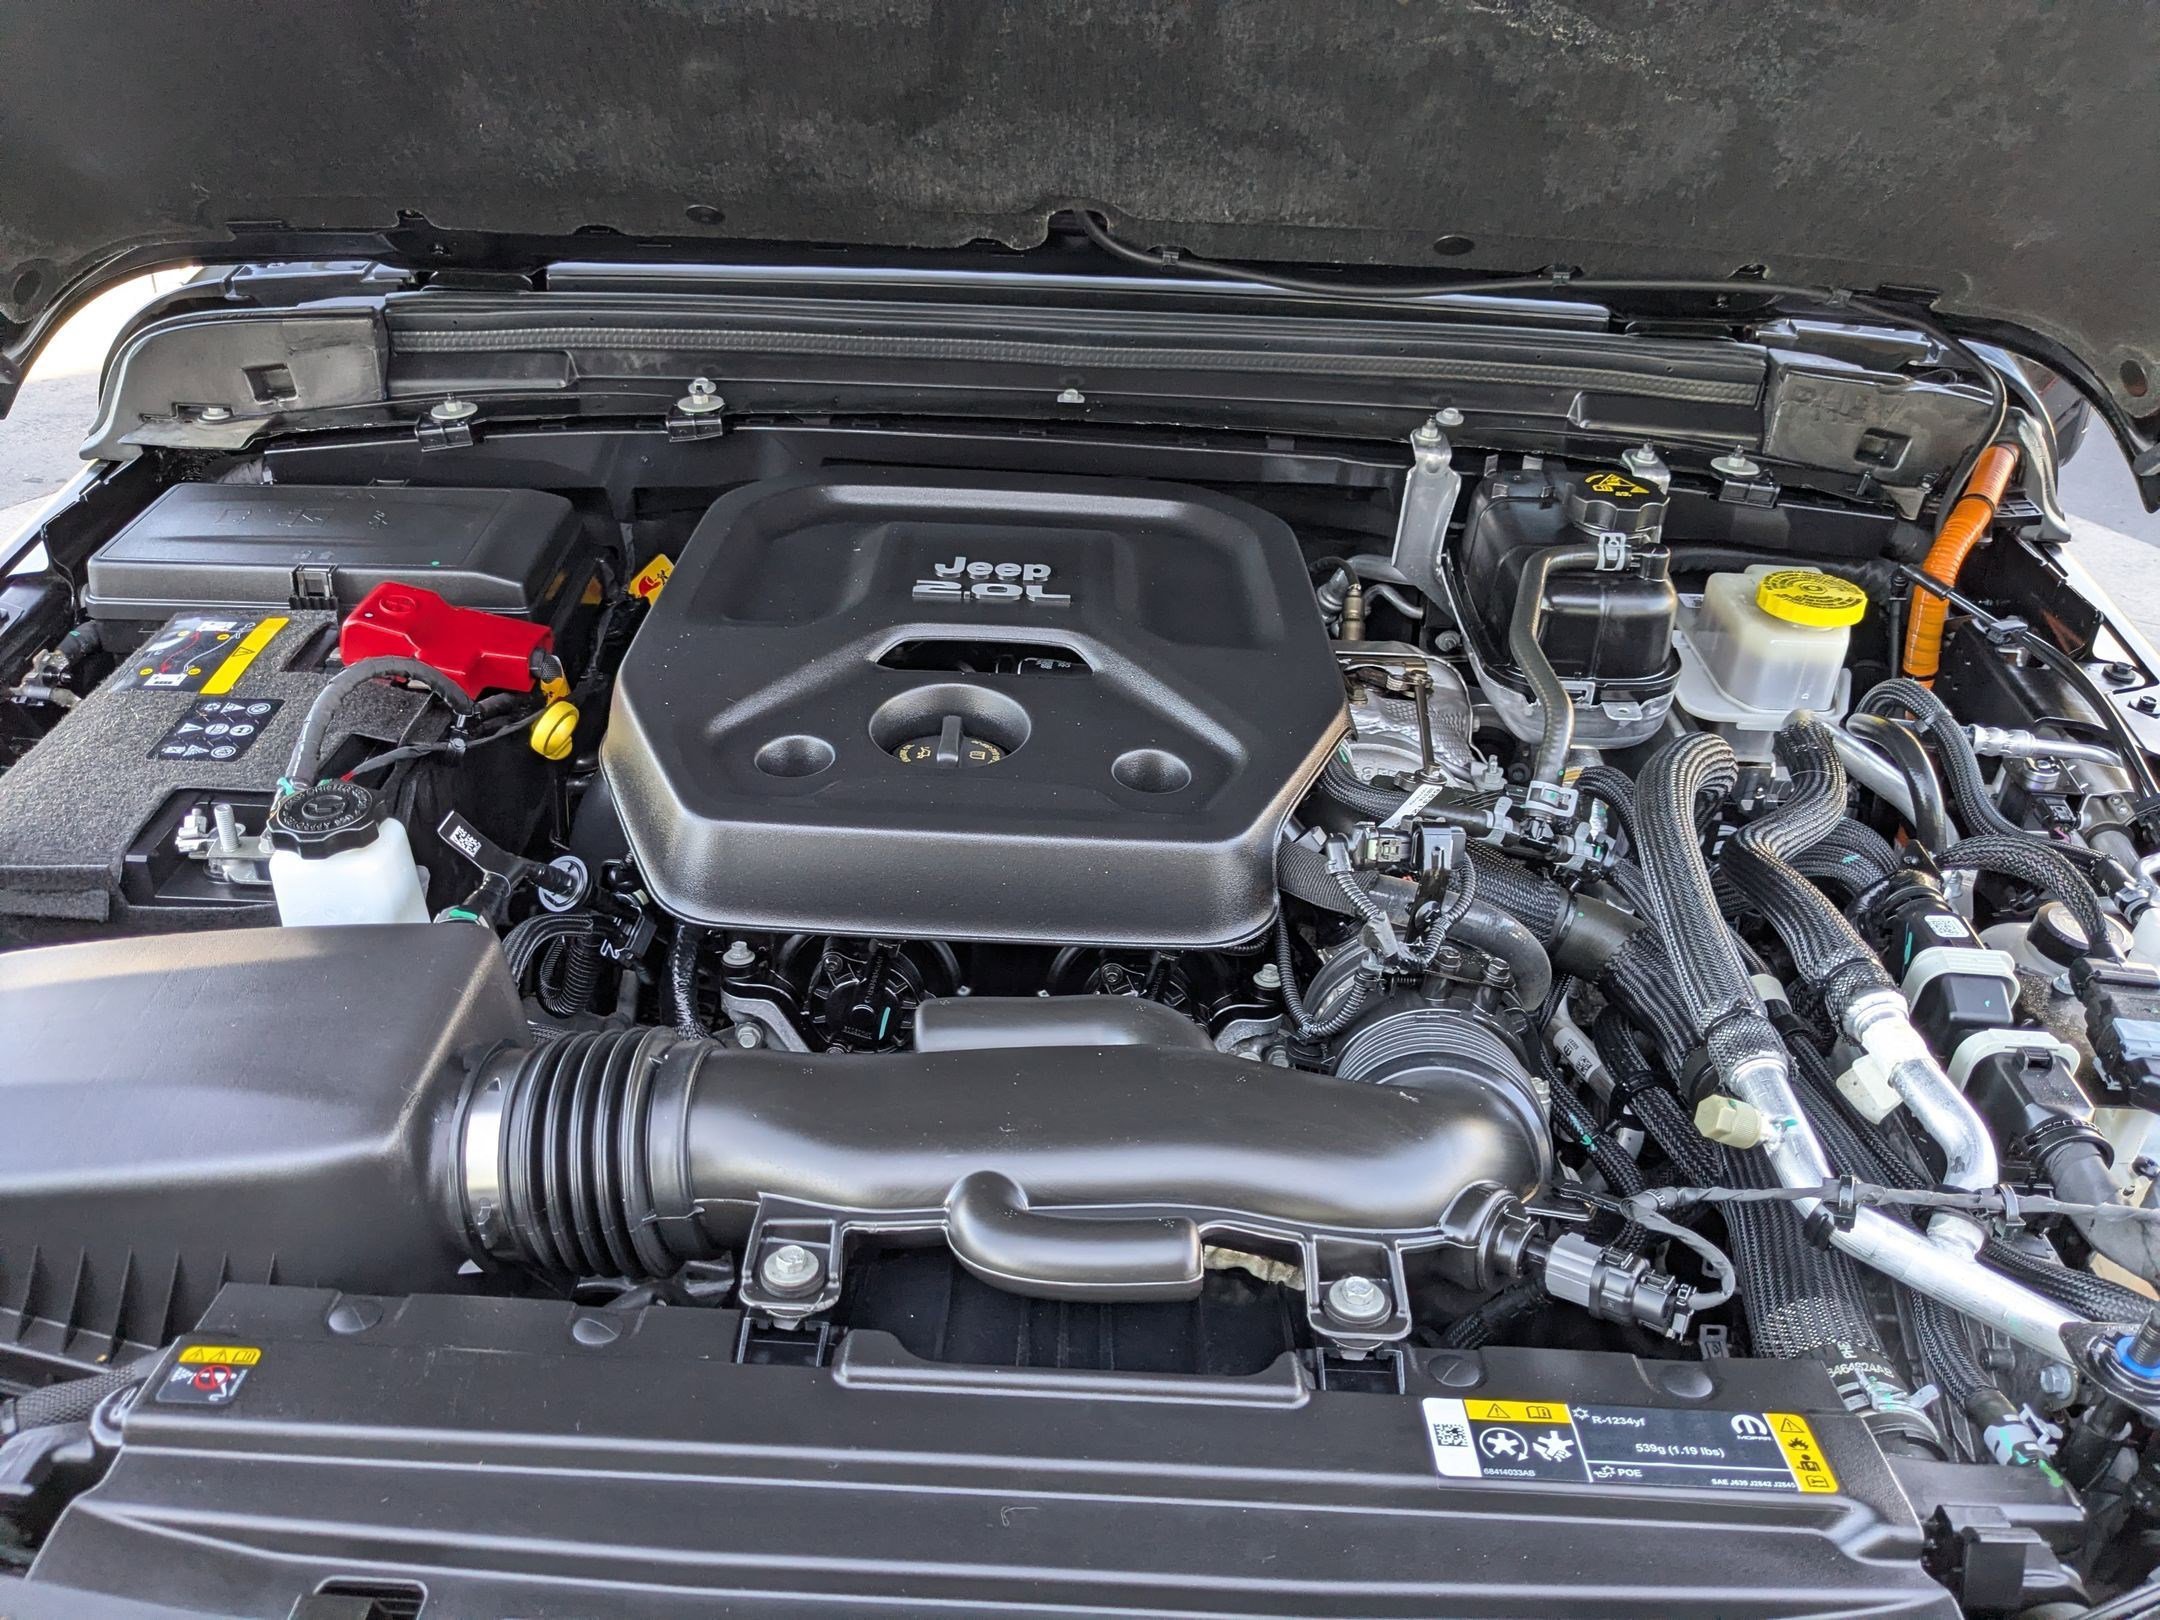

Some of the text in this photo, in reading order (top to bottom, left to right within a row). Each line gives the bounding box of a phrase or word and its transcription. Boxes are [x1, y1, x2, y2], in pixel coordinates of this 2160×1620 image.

[934, 556, 1052, 582] Jeep
[912, 579, 1072, 606] 2.0L
[1592, 1415, 1646, 1428] R-1234yf
[1635, 1442, 1725, 1459] 539g (1.19 lbs)
[1618, 1468, 1643, 1479] POE
[1711, 1477, 1729, 1486] SAE
